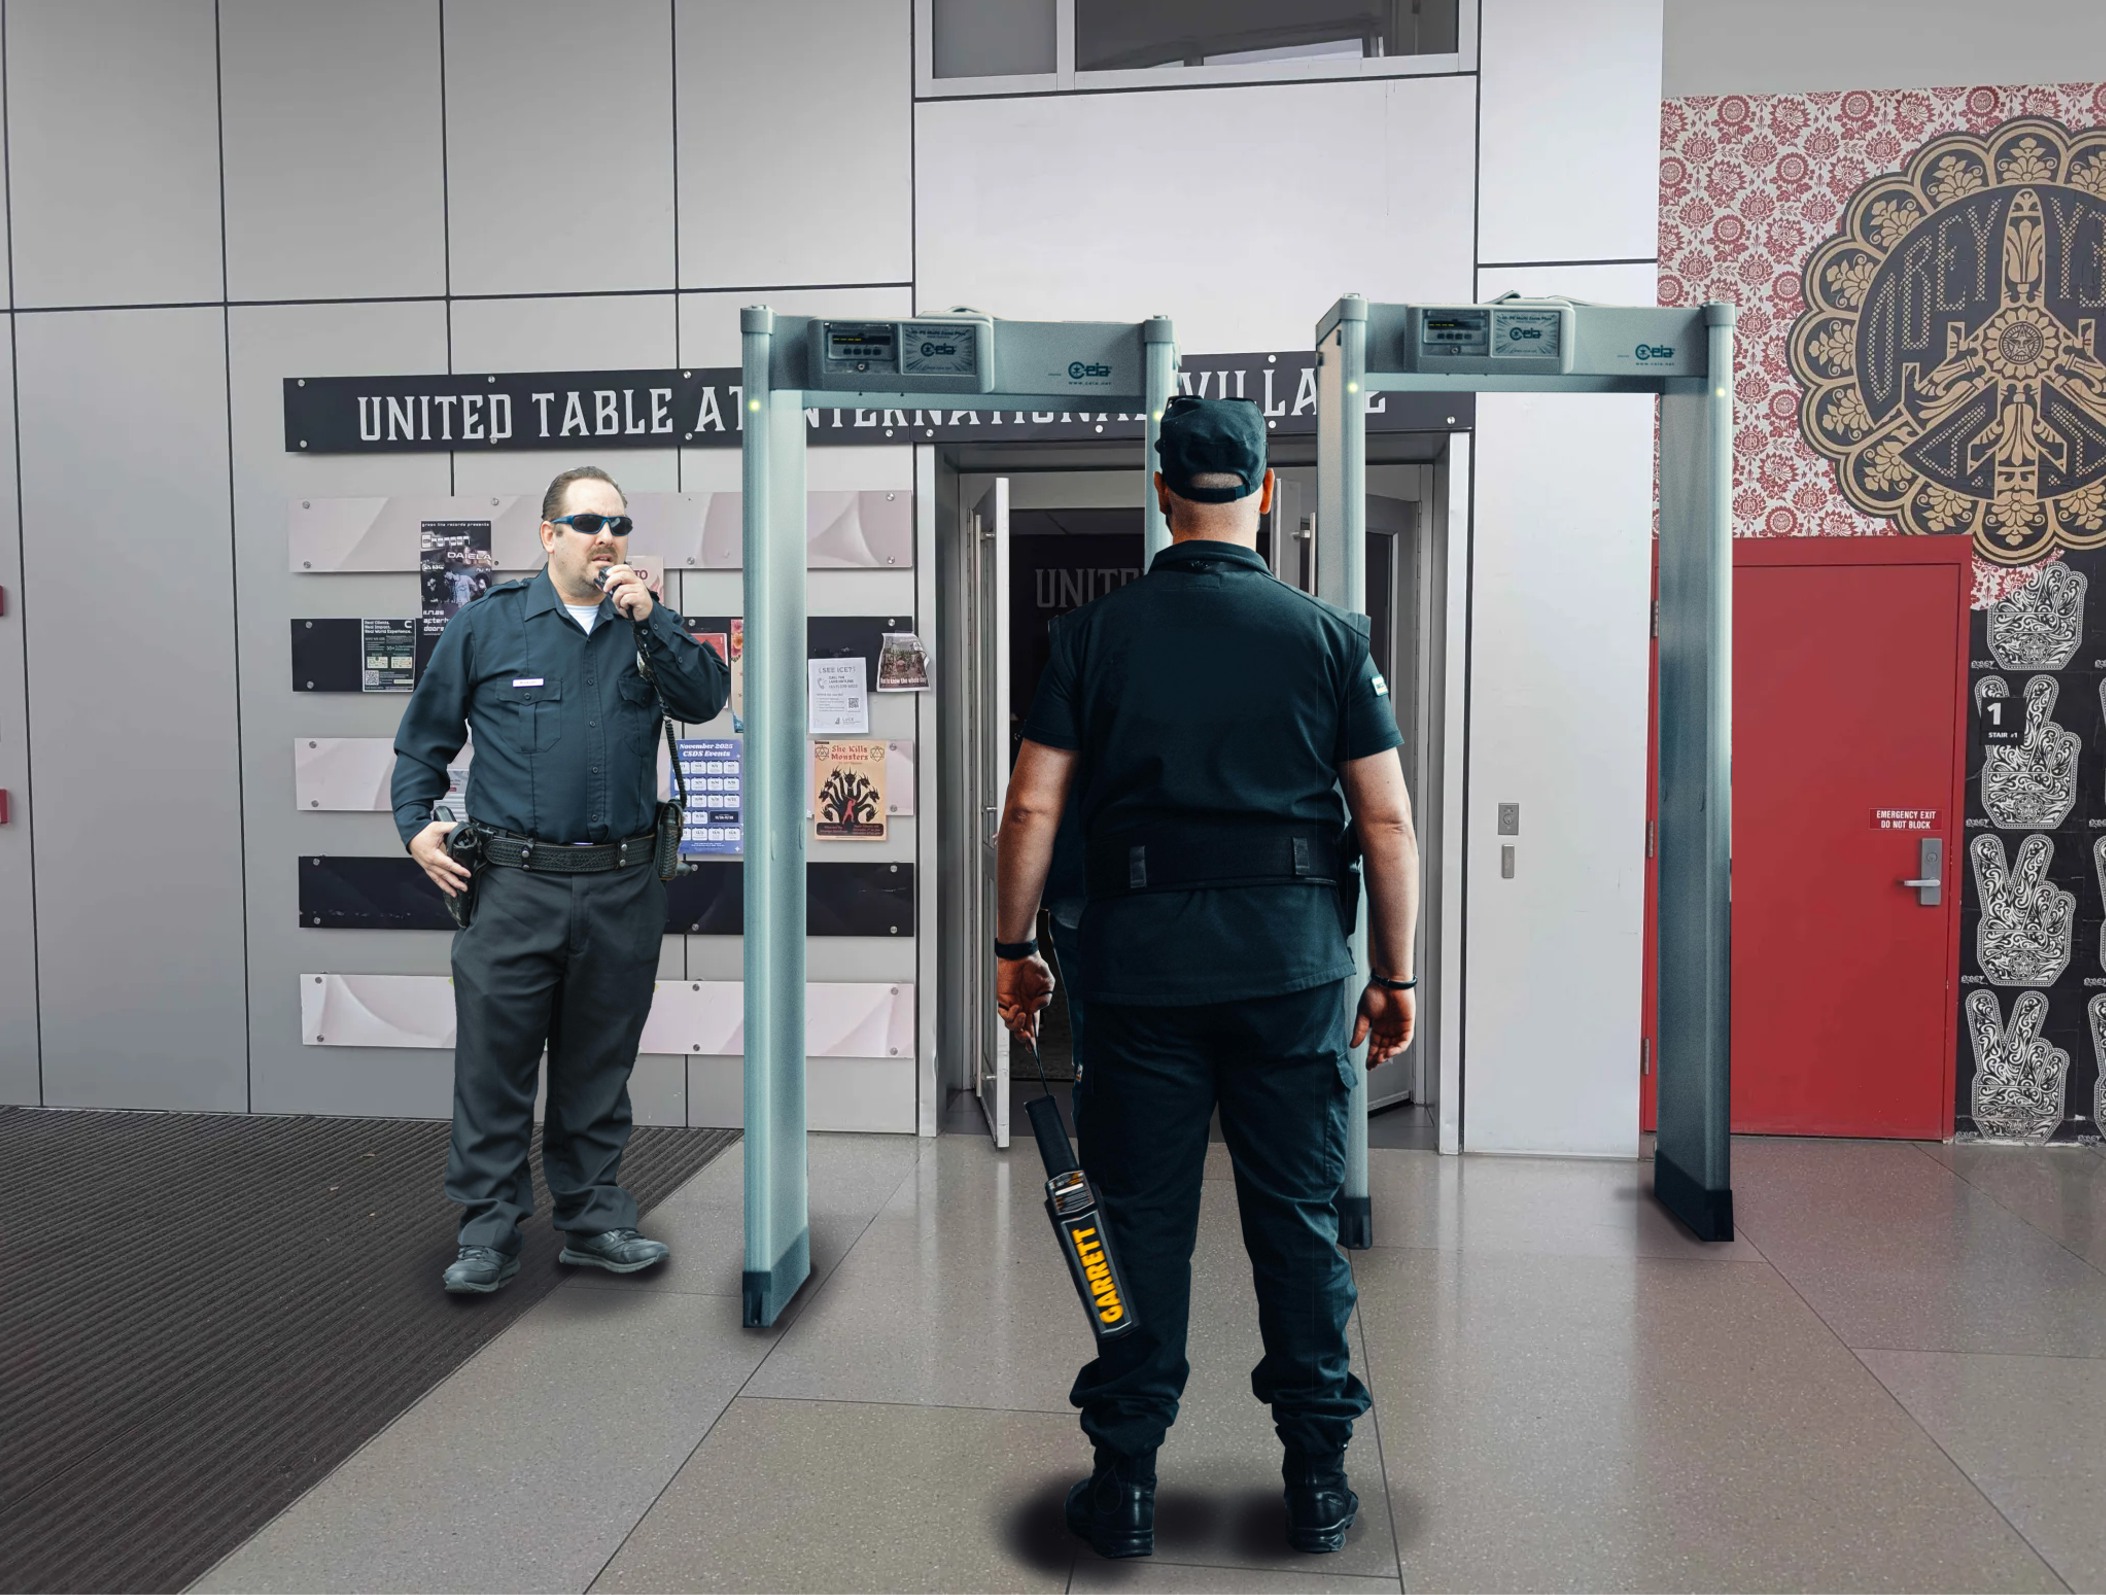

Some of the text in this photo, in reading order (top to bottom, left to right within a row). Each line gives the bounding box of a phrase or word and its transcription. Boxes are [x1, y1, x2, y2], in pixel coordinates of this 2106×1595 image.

[357, 393, 512, 441] UNITED
[532, 388, 674, 437] TABLE
[1035, 567, 1144, 608] UNIT
[1987, 702, 2002, 726] 1
[1876, 810, 1936, 819] EMERGENCY EXIT
[1881, 820, 1931, 829] DO NOT BLOCK
[1072, 1227, 1124, 1323] GARRETT
